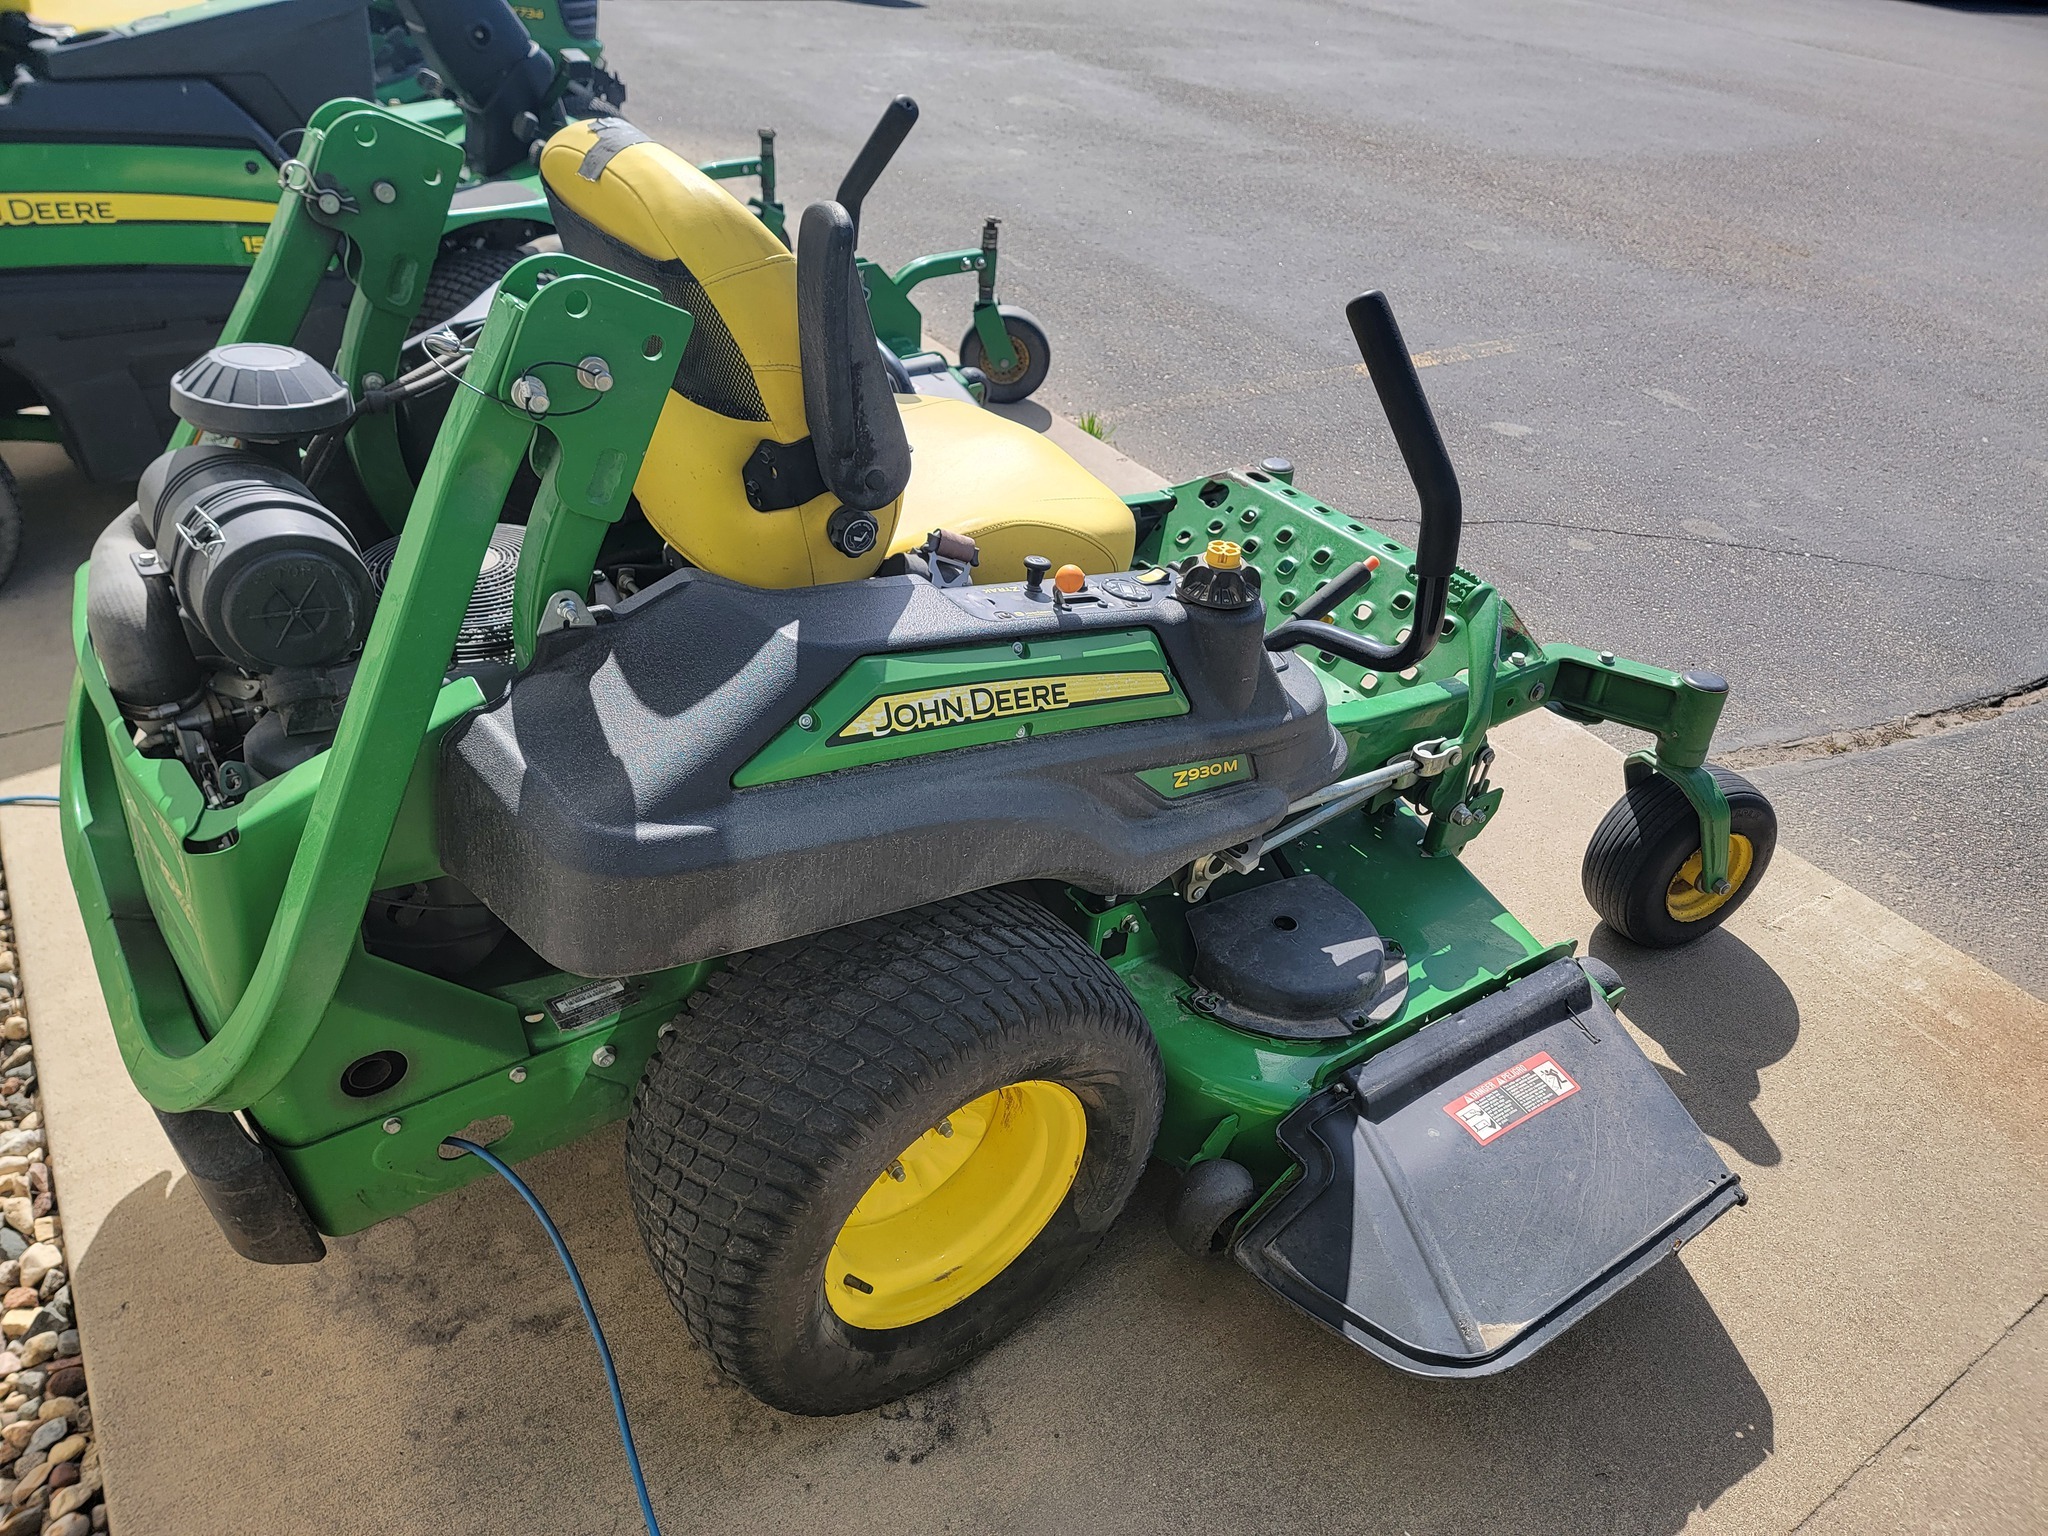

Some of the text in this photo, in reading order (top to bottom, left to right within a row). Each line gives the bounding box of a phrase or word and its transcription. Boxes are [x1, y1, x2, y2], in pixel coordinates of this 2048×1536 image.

[8, 199, 116, 220] DEERE
[875, 683, 1069, 732] JOHN DEERE
[1173, 759, 1238, 789] Z930M
[1470, 1082, 1496, 1098] DANGER
[1502, 1064, 1528, 1083] PELIGRO
